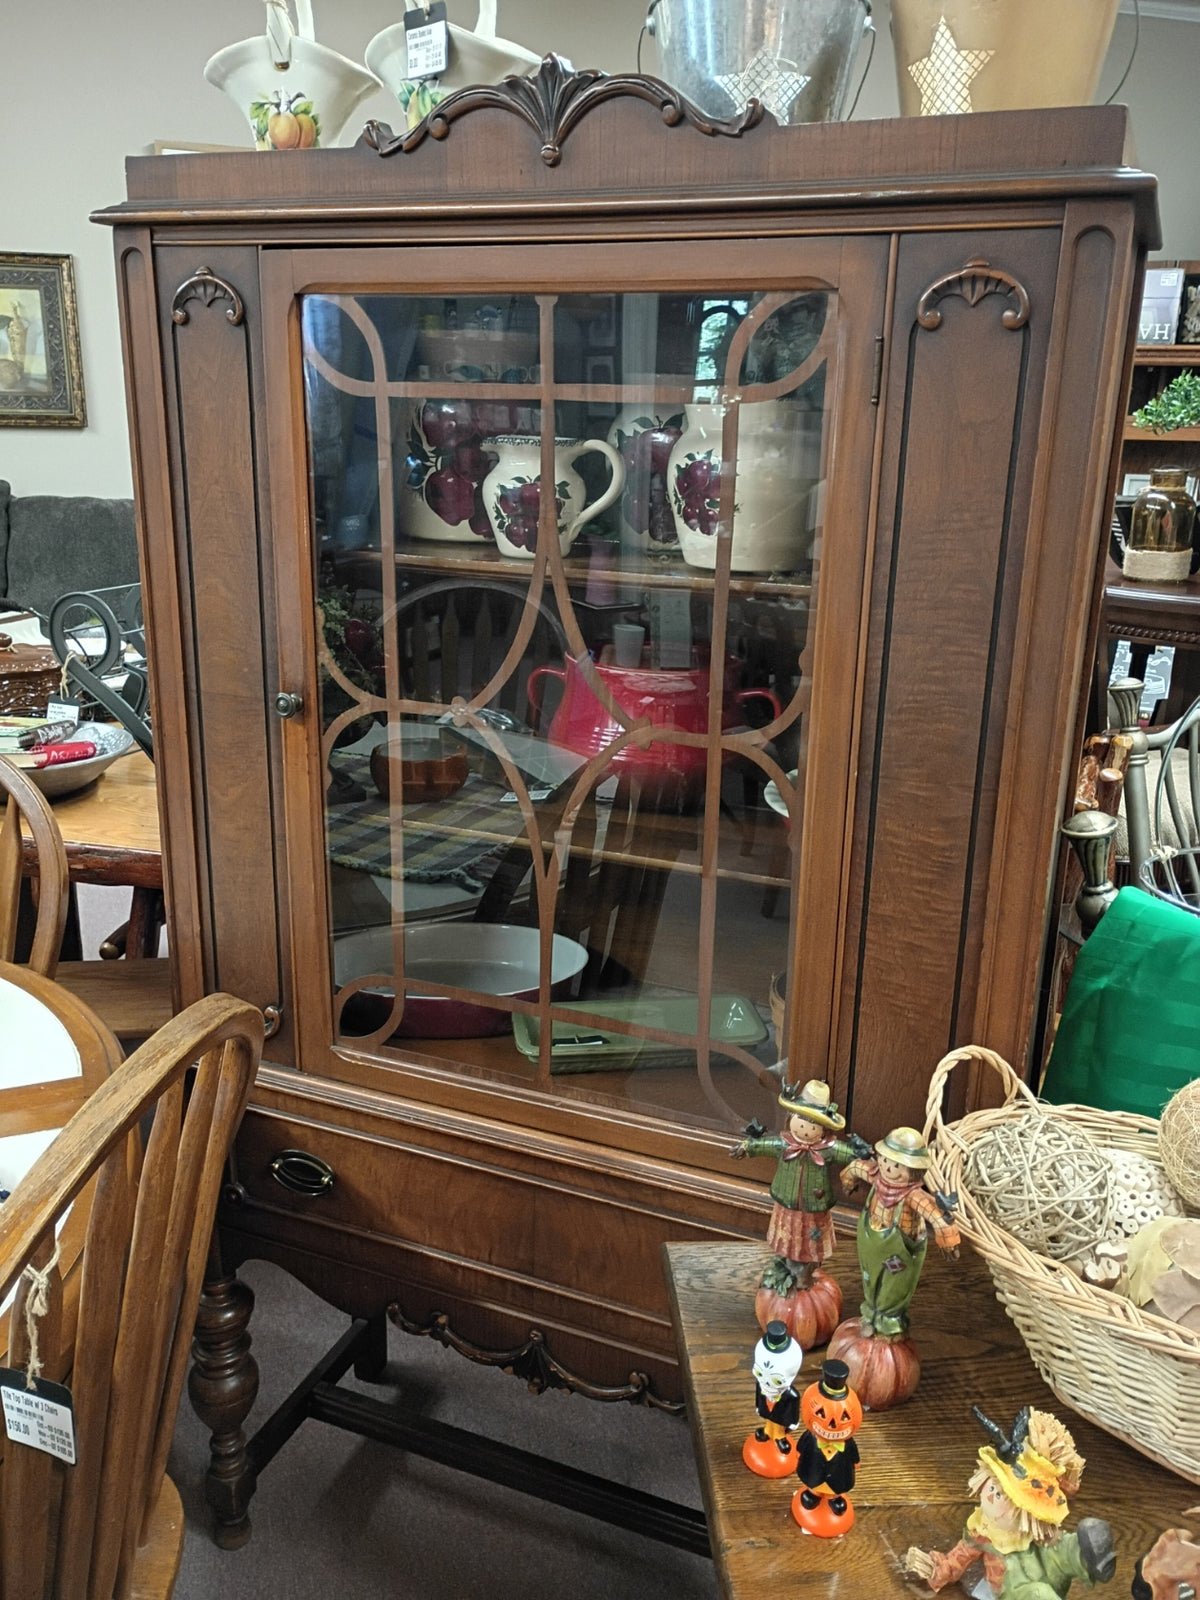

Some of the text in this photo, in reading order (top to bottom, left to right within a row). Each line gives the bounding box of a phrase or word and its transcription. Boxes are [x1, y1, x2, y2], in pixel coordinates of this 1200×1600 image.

[3, 1389, 12, 1400] Tile
[11, 1393, 21, 1404] Top
[21, 1395, 33, 1407] Table
[45, 1403, 58, 1416] Chairs
[8, 1419, 30, 1436] $150.00
